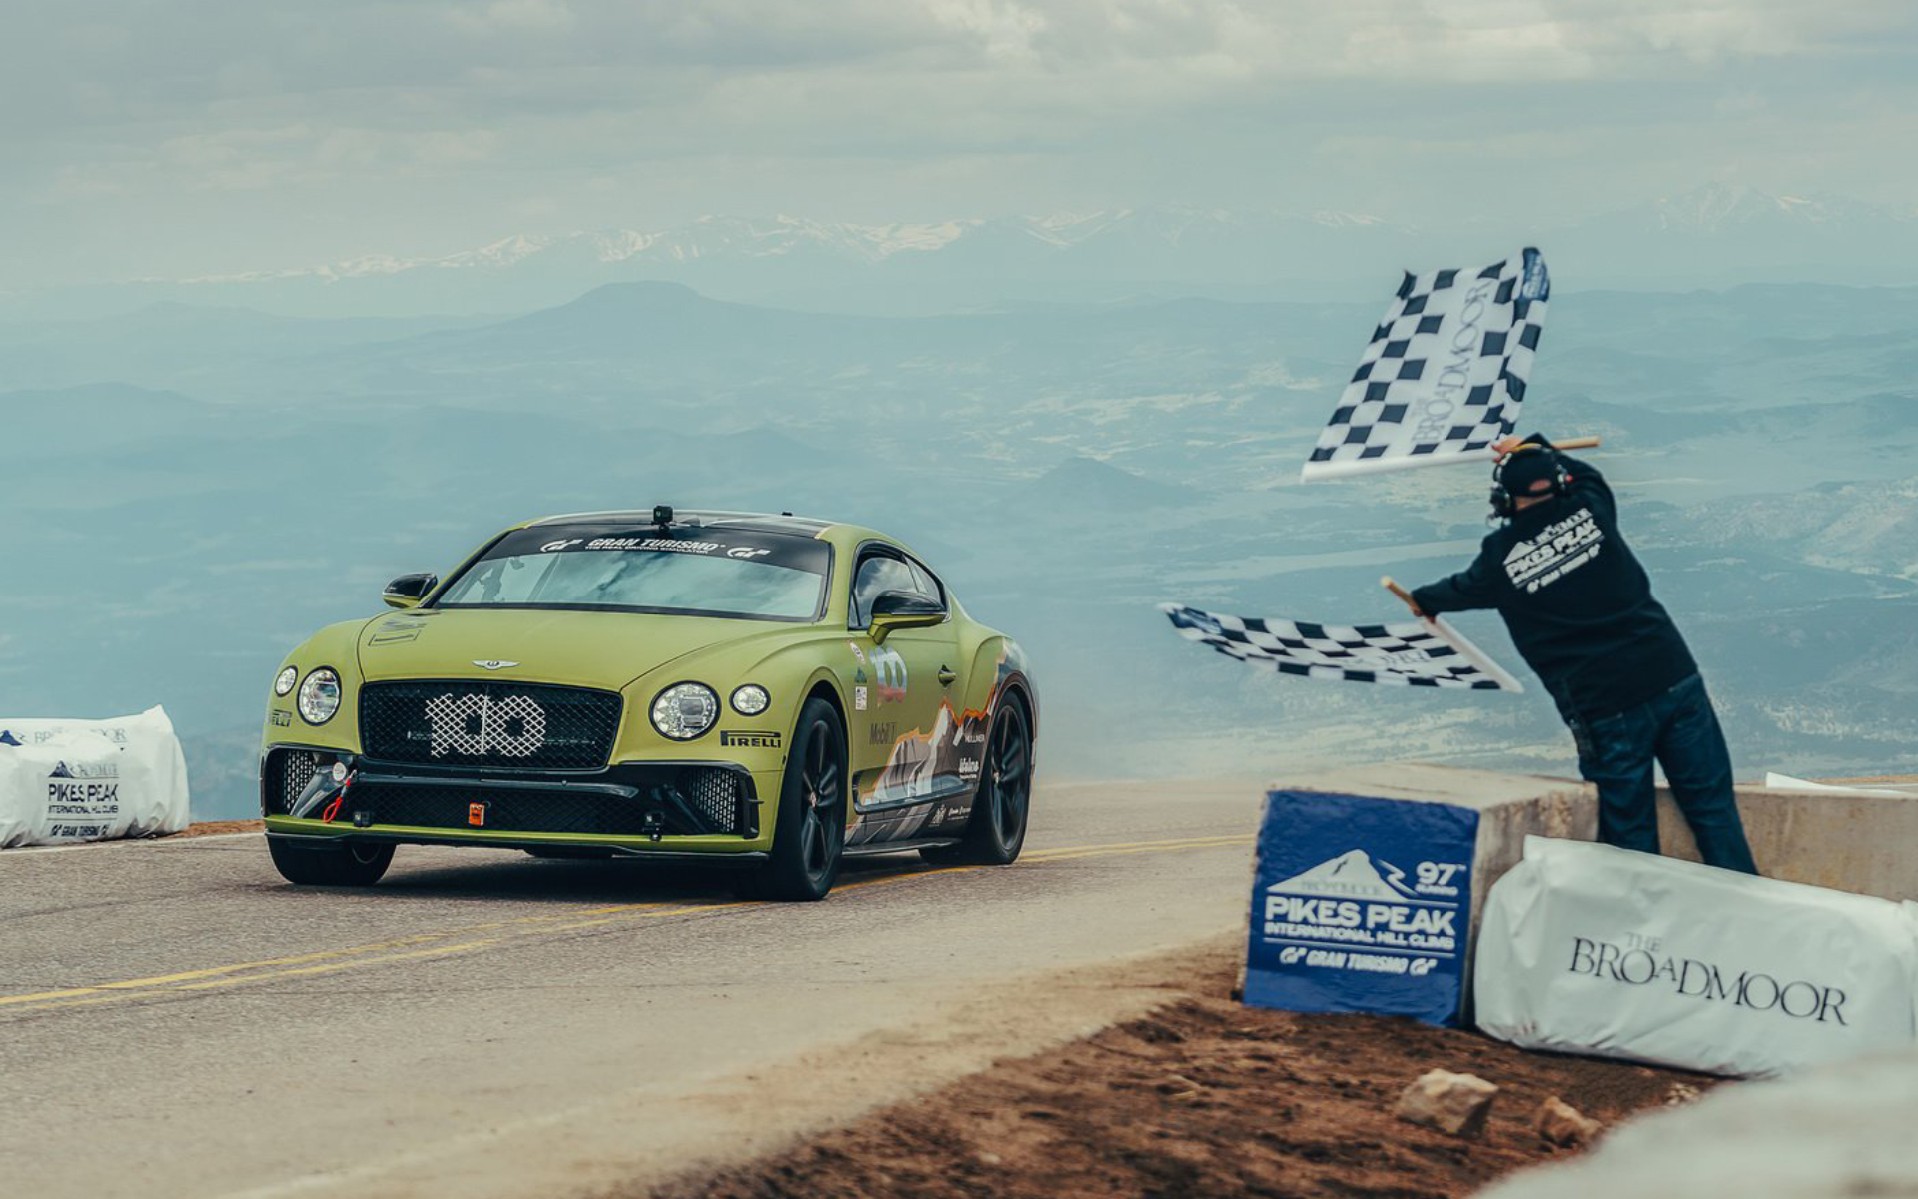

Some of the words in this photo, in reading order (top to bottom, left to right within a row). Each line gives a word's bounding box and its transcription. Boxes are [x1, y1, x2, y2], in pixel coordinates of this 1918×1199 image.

[1411, 280, 1493, 442] BROADMOOR
[588, 538, 641, 548] GRAN
[643, 538, 720, 551] TURISMO
[1505, 544, 1556, 578] PIKES
[1552, 518, 1598, 553] PEAK
[425, 693, 546, 758] 100
[720, 730, 782, 749] PIRELLI
[48, 783, 86, 802] PIKES
[87, 783, 119, 802] PEAK
[1265, 895, 1362, 928] PIKES
[1366, 904, 1456, 936] PEAK
[1264, 921, 1375, 944] INTERNATIONAL
[1376, 931, 1408, 946] HILL
[1408, 934, 1455, 950] CLIMB
[1625, 931, 1662, 952] THE
[1306, 949, 1348, 968] GRAN
[1569, 936, 1848, 1026] BROADMOOR
